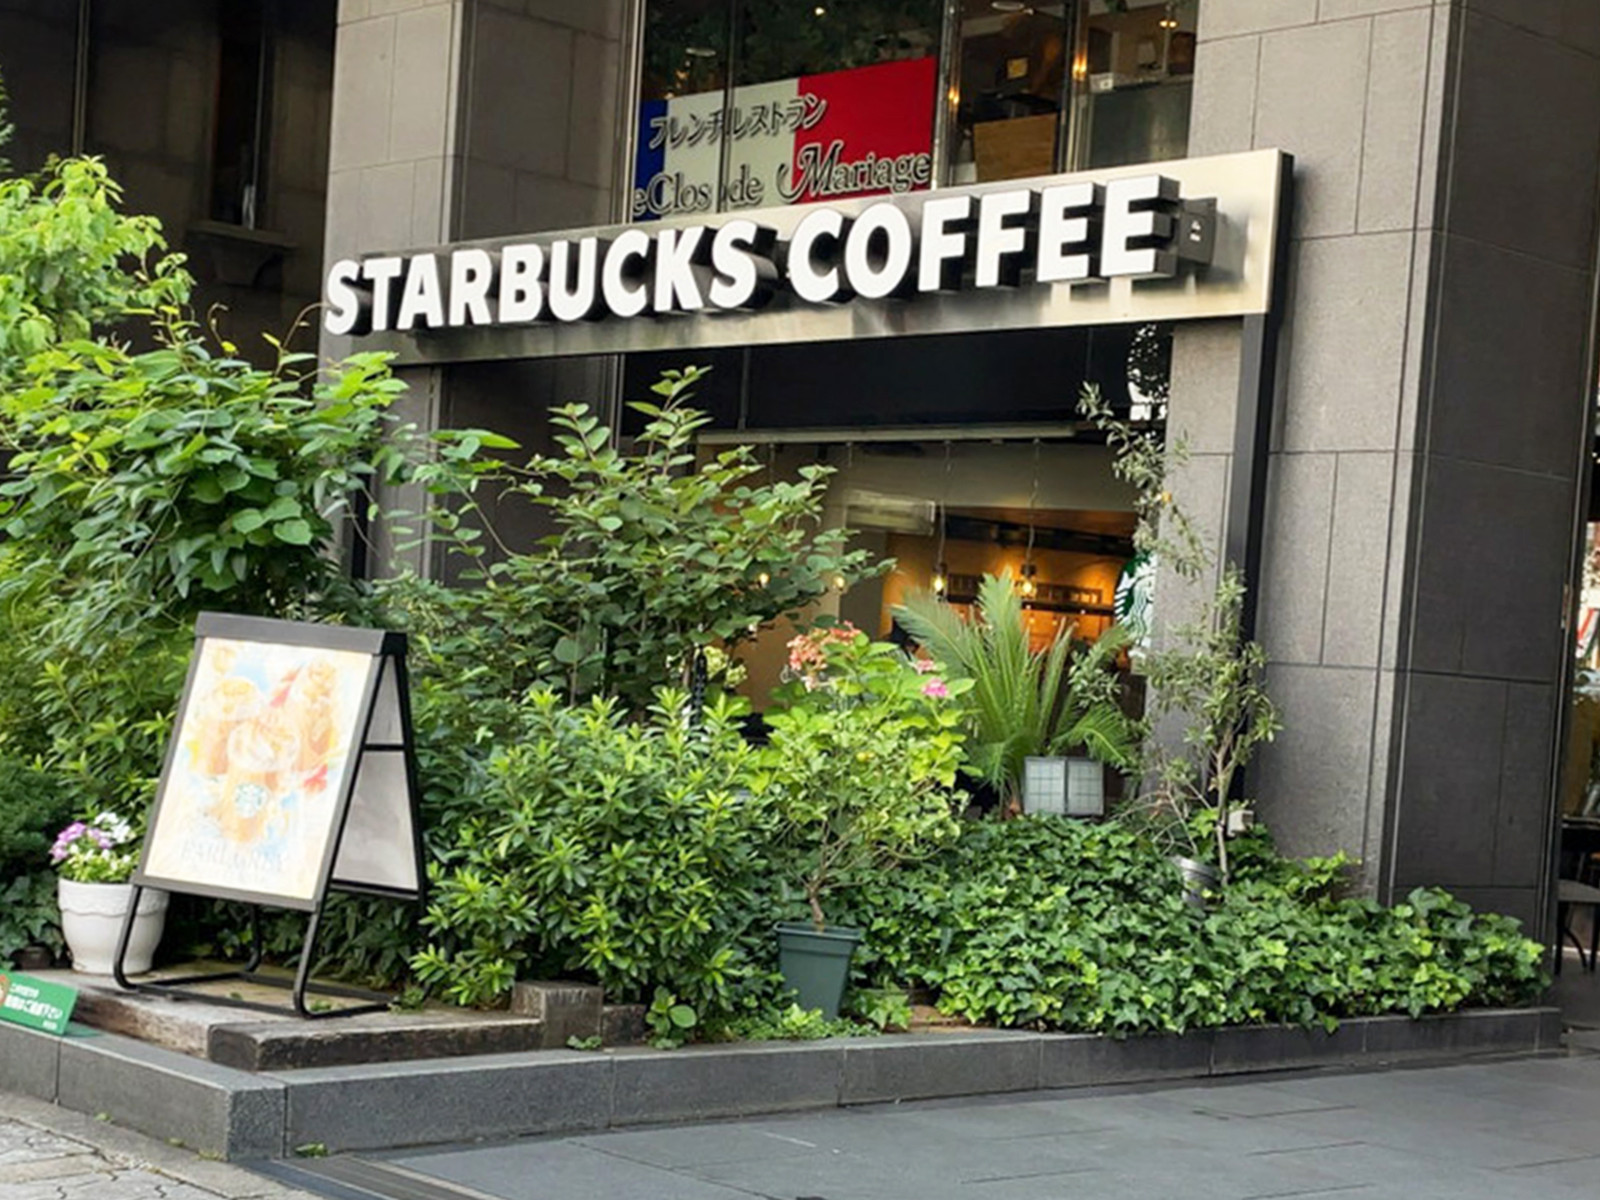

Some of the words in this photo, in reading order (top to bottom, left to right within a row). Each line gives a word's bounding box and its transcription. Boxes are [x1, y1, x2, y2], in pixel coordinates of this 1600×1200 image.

[646, 171, 714, 215] Clos
[728, 164, 765, 208] de
[776, 139, 932, 204] Mariage
[325, 219, 760, 336] STARBUCKS
[788, 174, 1162, 302] COFFEE
